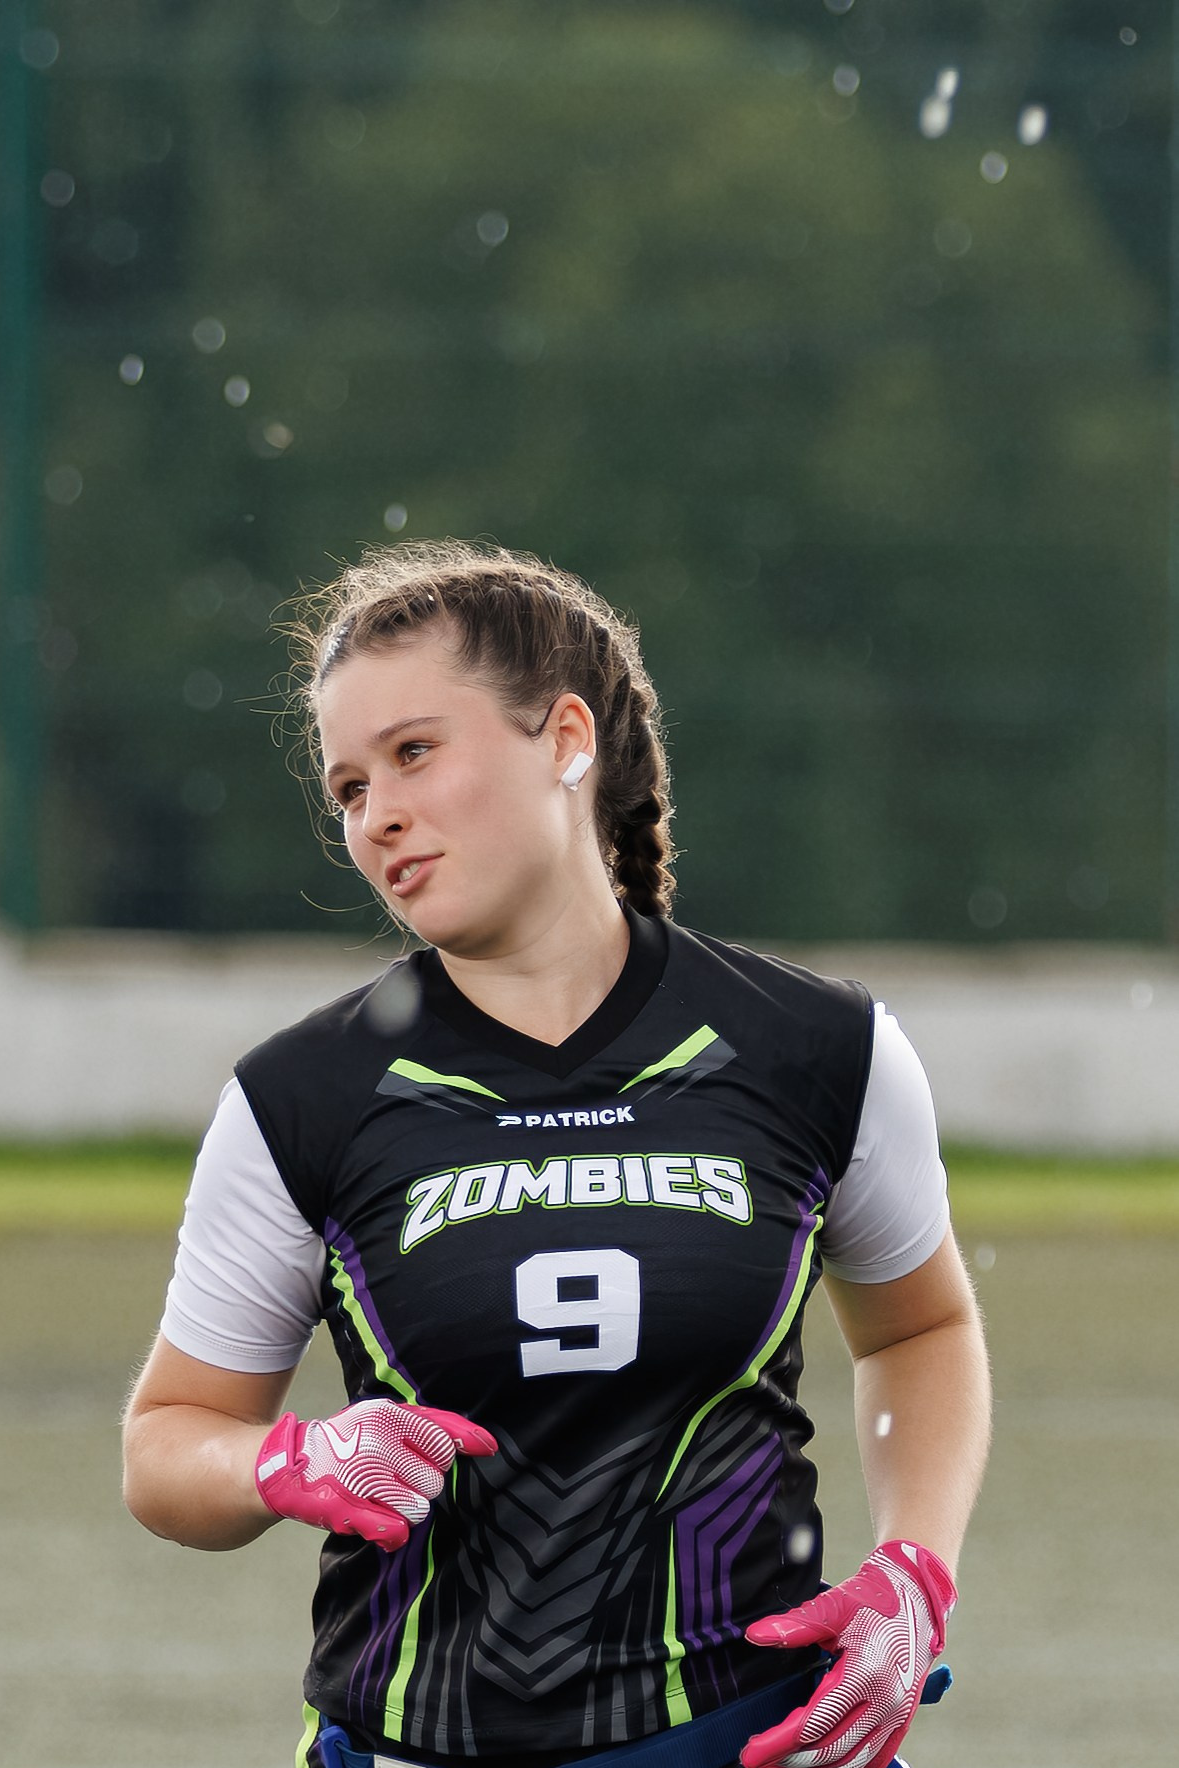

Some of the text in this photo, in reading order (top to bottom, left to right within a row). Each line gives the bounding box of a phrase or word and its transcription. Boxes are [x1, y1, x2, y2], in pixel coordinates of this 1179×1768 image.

[525, 1105, 635, 1127] PATRICK
[400, 1154, 754, 1254] ZOMBIES
[515, 1248, 641, 1377] 9
